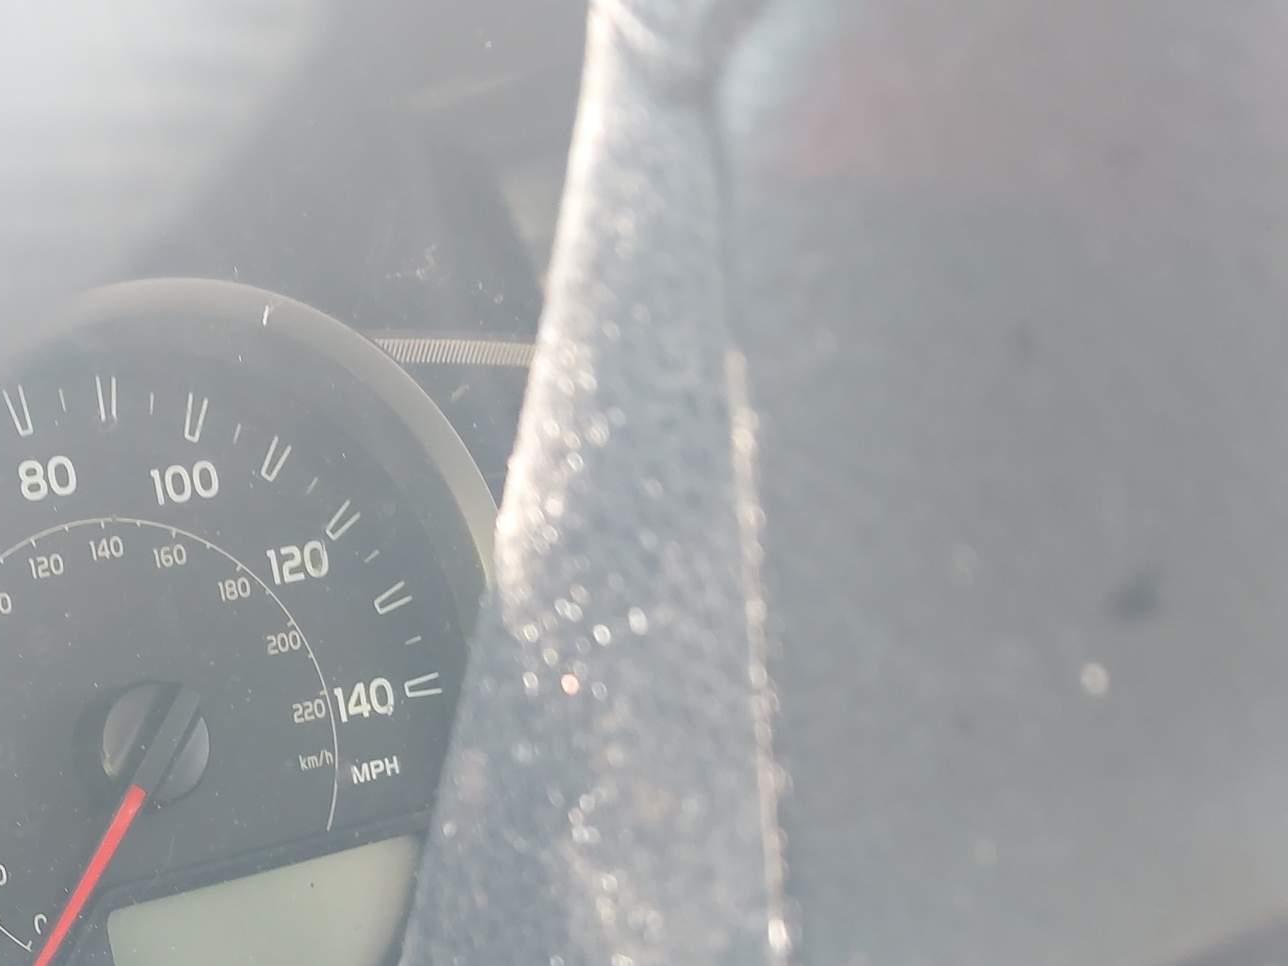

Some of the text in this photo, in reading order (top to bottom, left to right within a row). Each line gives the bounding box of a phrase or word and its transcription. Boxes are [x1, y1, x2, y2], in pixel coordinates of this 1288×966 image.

[17, 454, 78, 501] 80
[150, 459, 221, 506] 100
[88, 536, 125, 561] 140
[152, 543, 188, 569] 160
[266, 538, 330, 585] 120
[28, 551, 66, 579] 120
[217, 576, 252, 602] 180
[265, 629, 302, 655] 200
[291, 698, 326, 723] 220
[333, 677, 396, 720] 140
[298, 748, 334, 772] km/h
[350, 755, 401, 786] MPH
